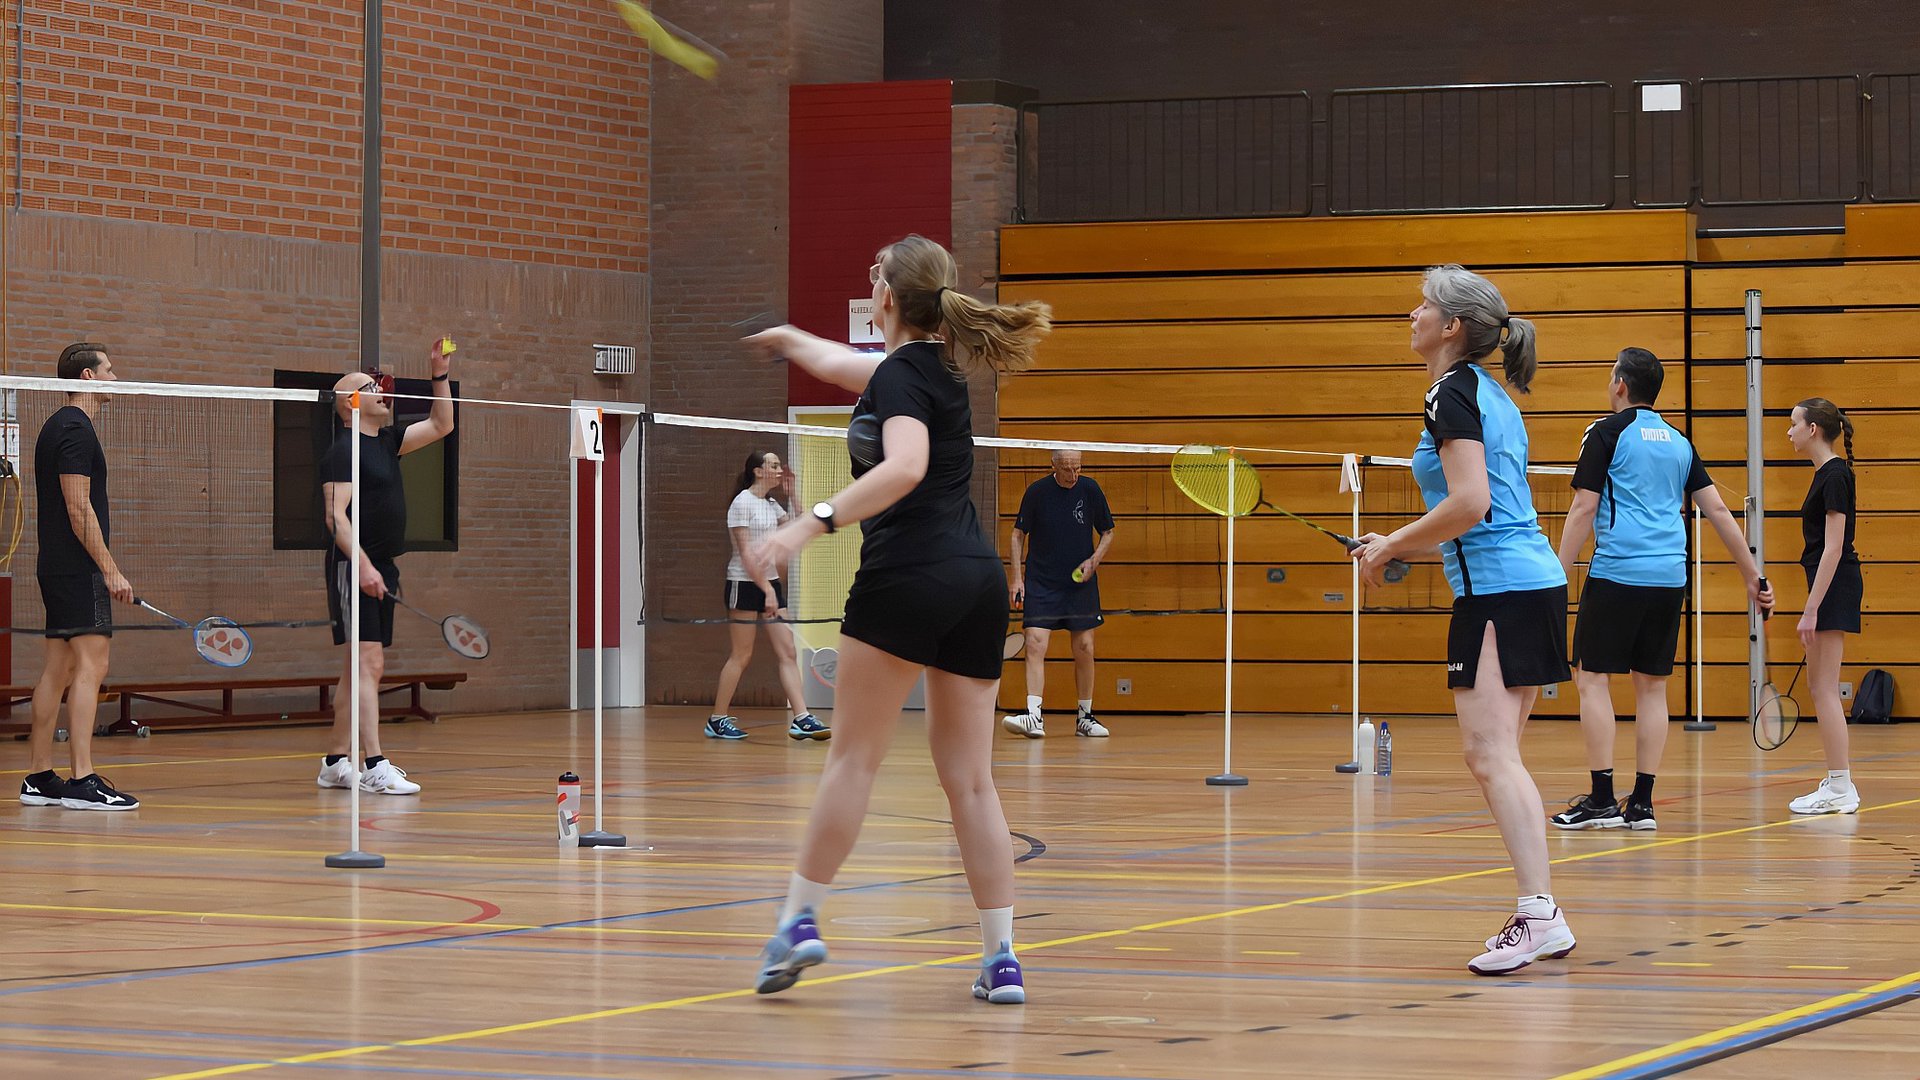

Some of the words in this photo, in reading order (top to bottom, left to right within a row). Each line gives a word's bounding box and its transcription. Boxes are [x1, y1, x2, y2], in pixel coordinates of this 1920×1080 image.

[866, 319, 873, 336] 1
[590, 420, 602, 454] 2
[1640, 427, 1672, 442] DIDIER
